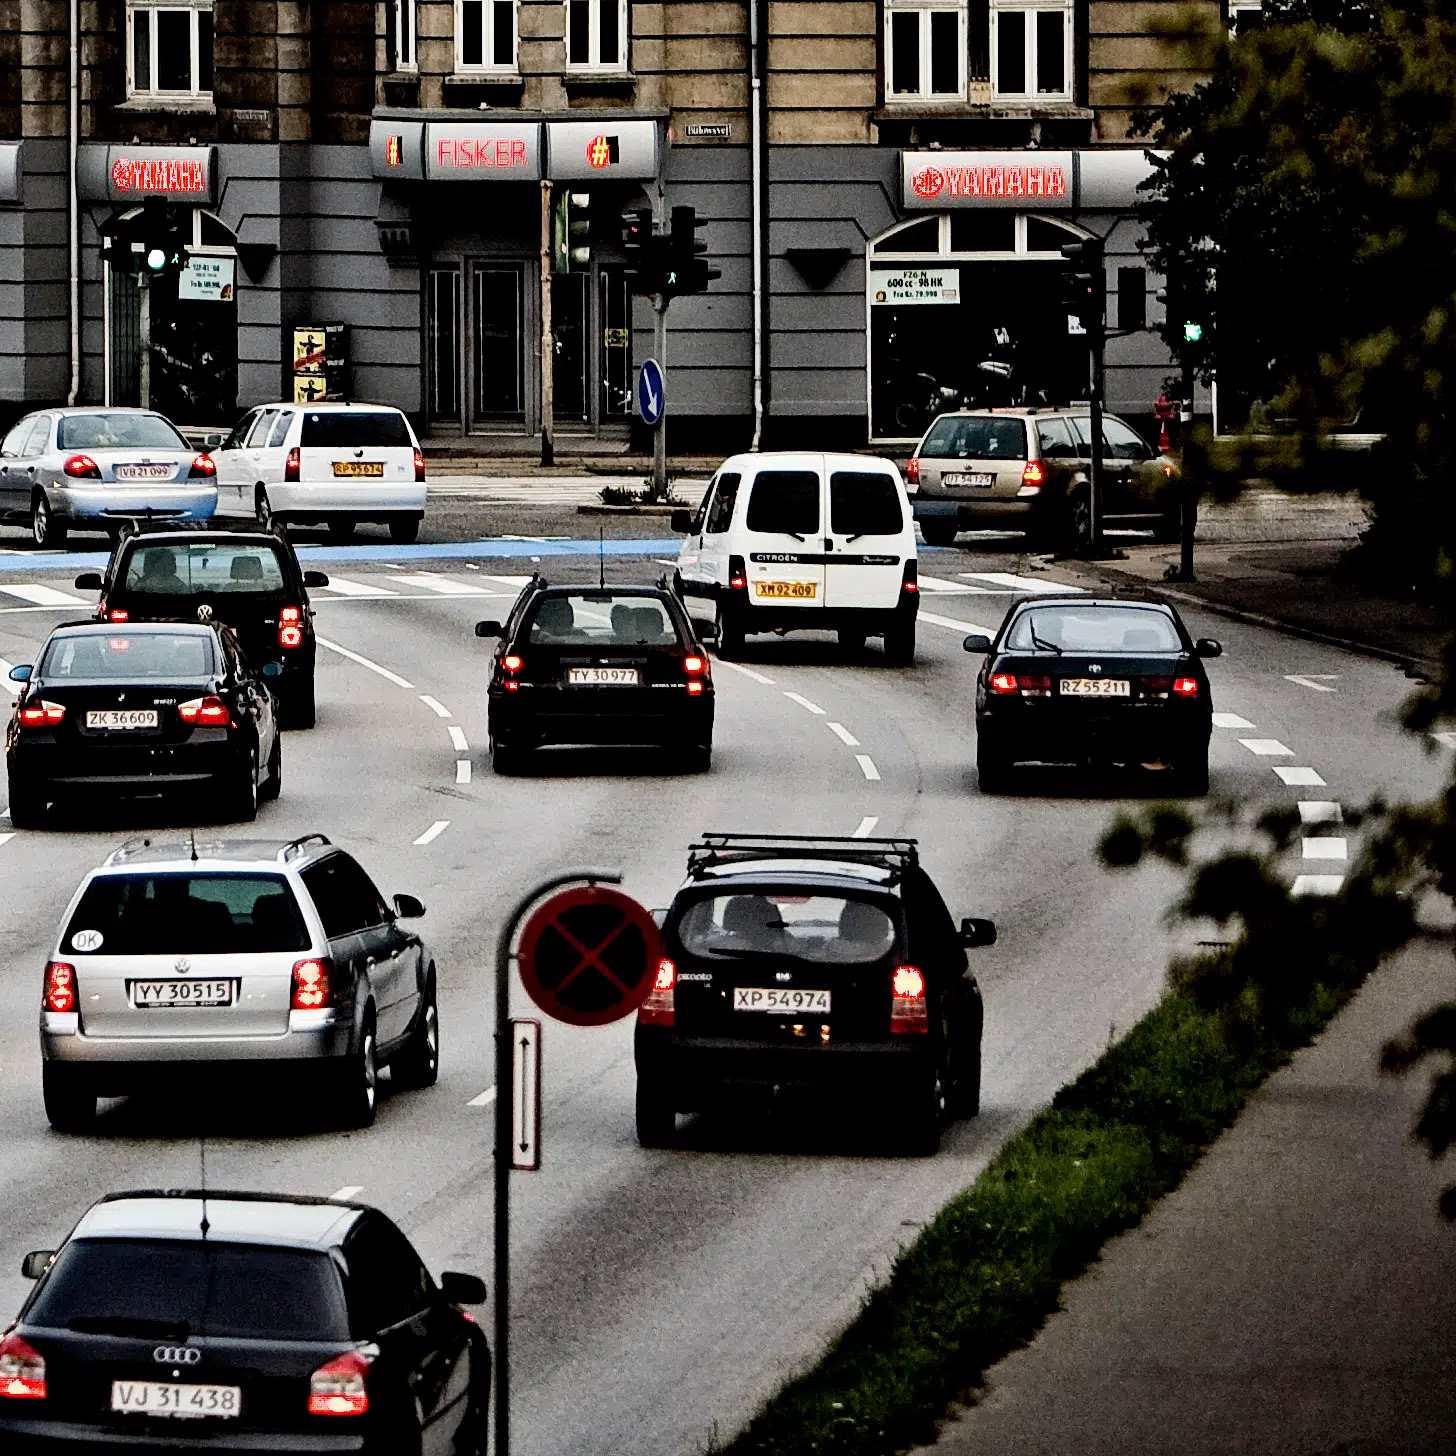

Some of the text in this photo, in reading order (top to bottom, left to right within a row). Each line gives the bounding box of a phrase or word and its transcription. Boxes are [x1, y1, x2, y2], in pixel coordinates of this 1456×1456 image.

[436, 138, 528, 168] FISKER
[129, 158, 206, 192] YAMAHA
[944, 164, 1067, 198] YAMAHA
[887, 277, 943, 288] 600 cc 98 HK
[137, 467, 148, 476] 21
[792, 584, 812, 596] 409
[573, 670, 636, 681] TY 30 977
[1062, 680, 1126, 694] RZ 55 211
[89, 712, 108, 725] ZK
[76, 933, 98, 948] DK
[139, 984, 164, 1000] YY
[737, 990, 763, 1007] XP
[118, 1384, 236, 1411] VJ 31 438
